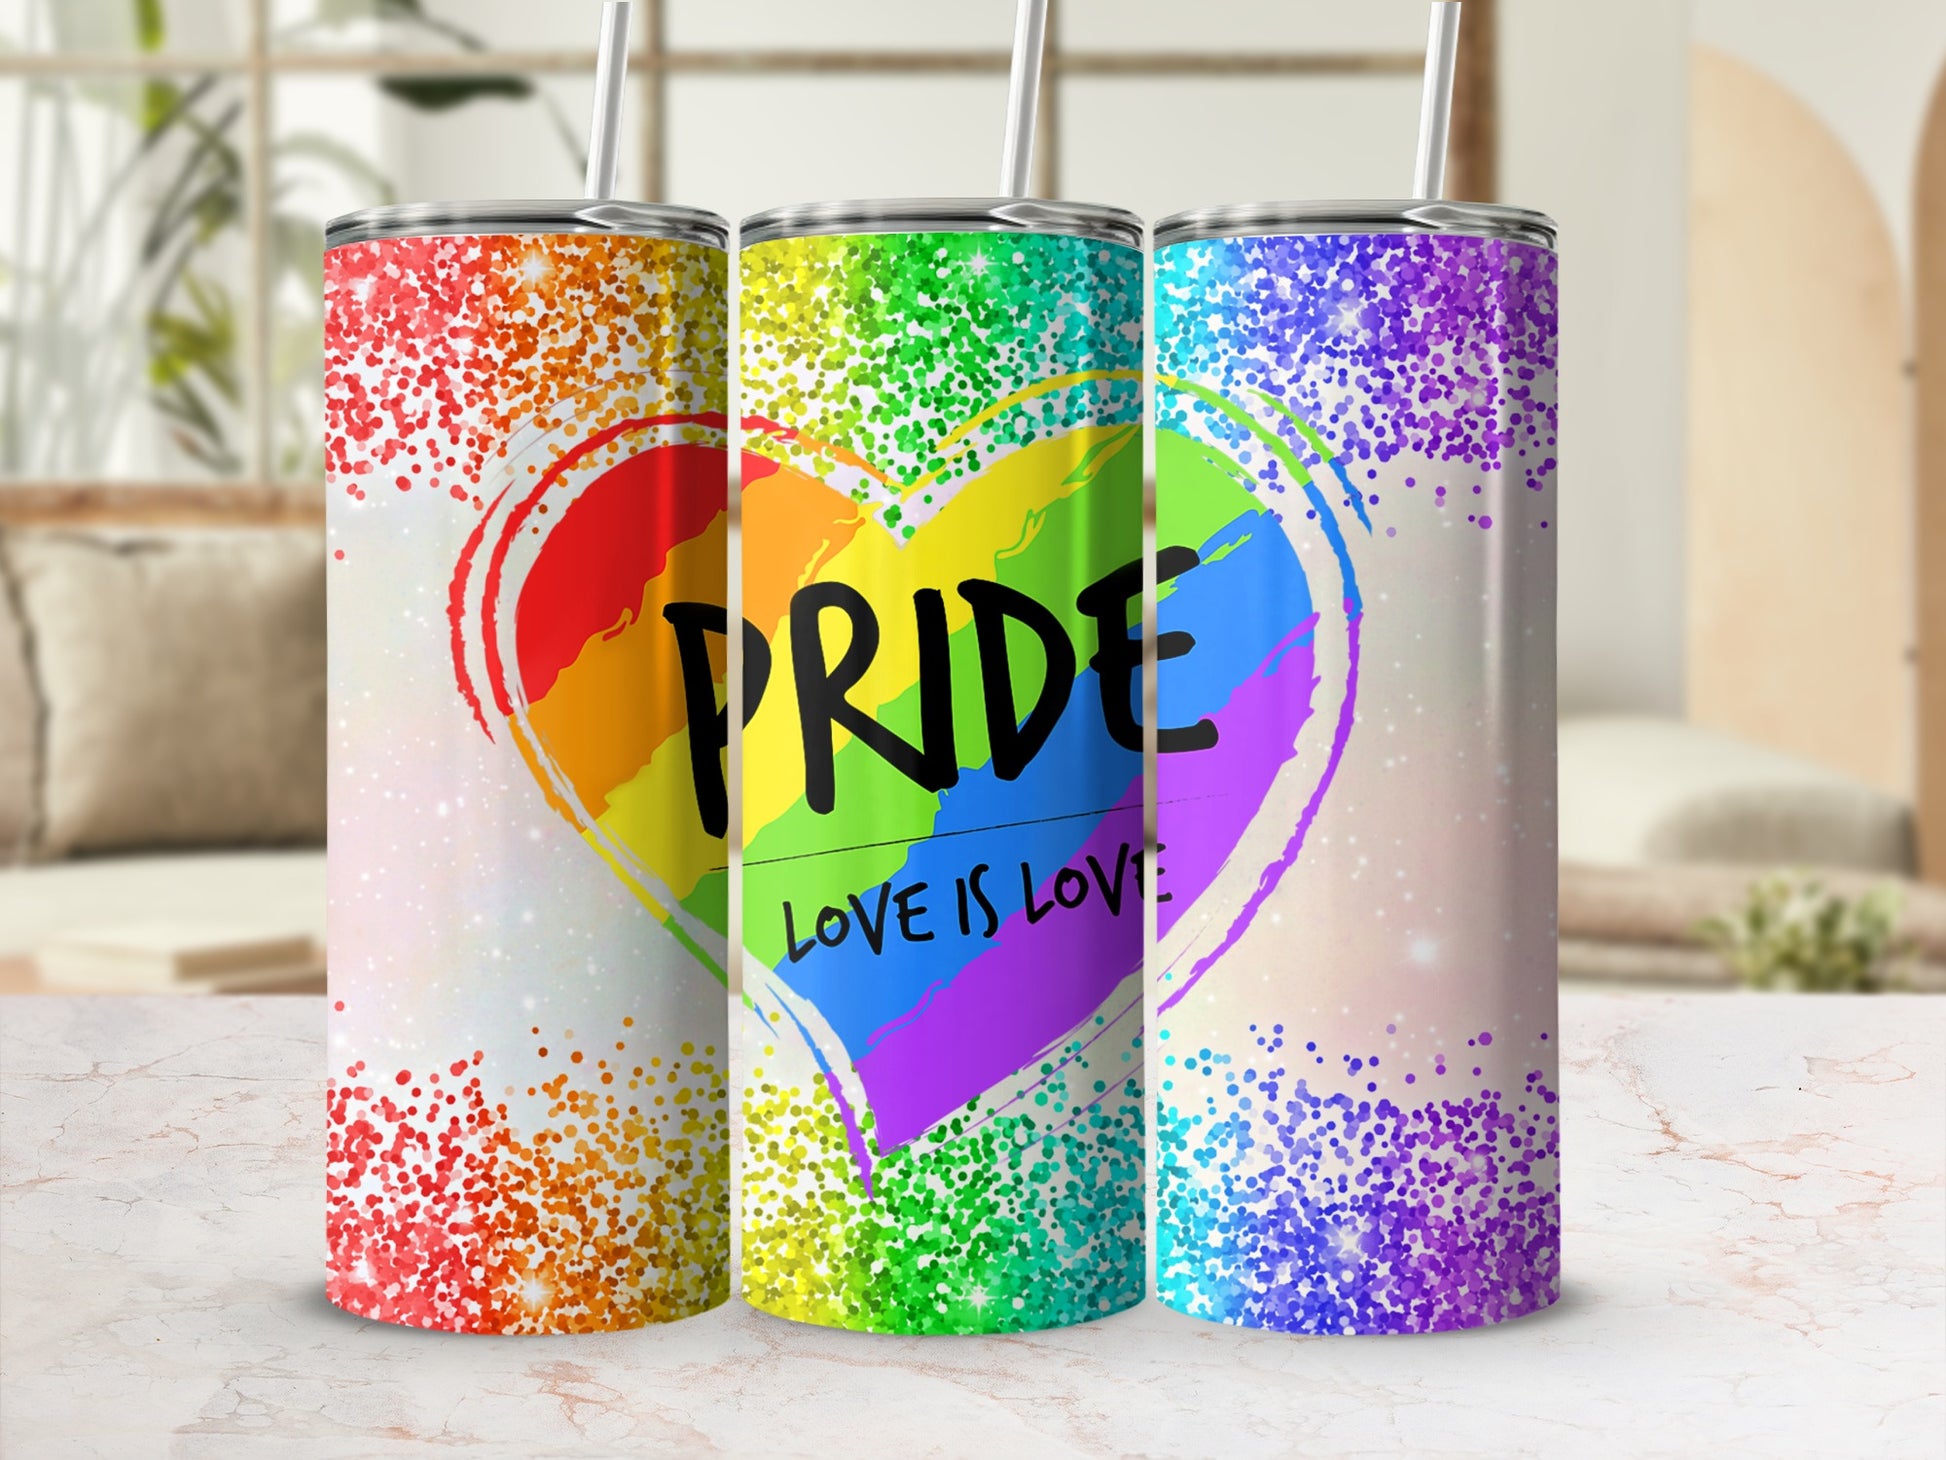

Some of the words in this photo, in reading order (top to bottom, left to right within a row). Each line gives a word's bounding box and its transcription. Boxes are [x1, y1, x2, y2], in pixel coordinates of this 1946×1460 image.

[663, 546, 1219, 839] PRIDE
[782, 881, 935, 963] LOVE
[955, 863, 999, 938] IS
[1020, 842, 1173, 924] LOVE
